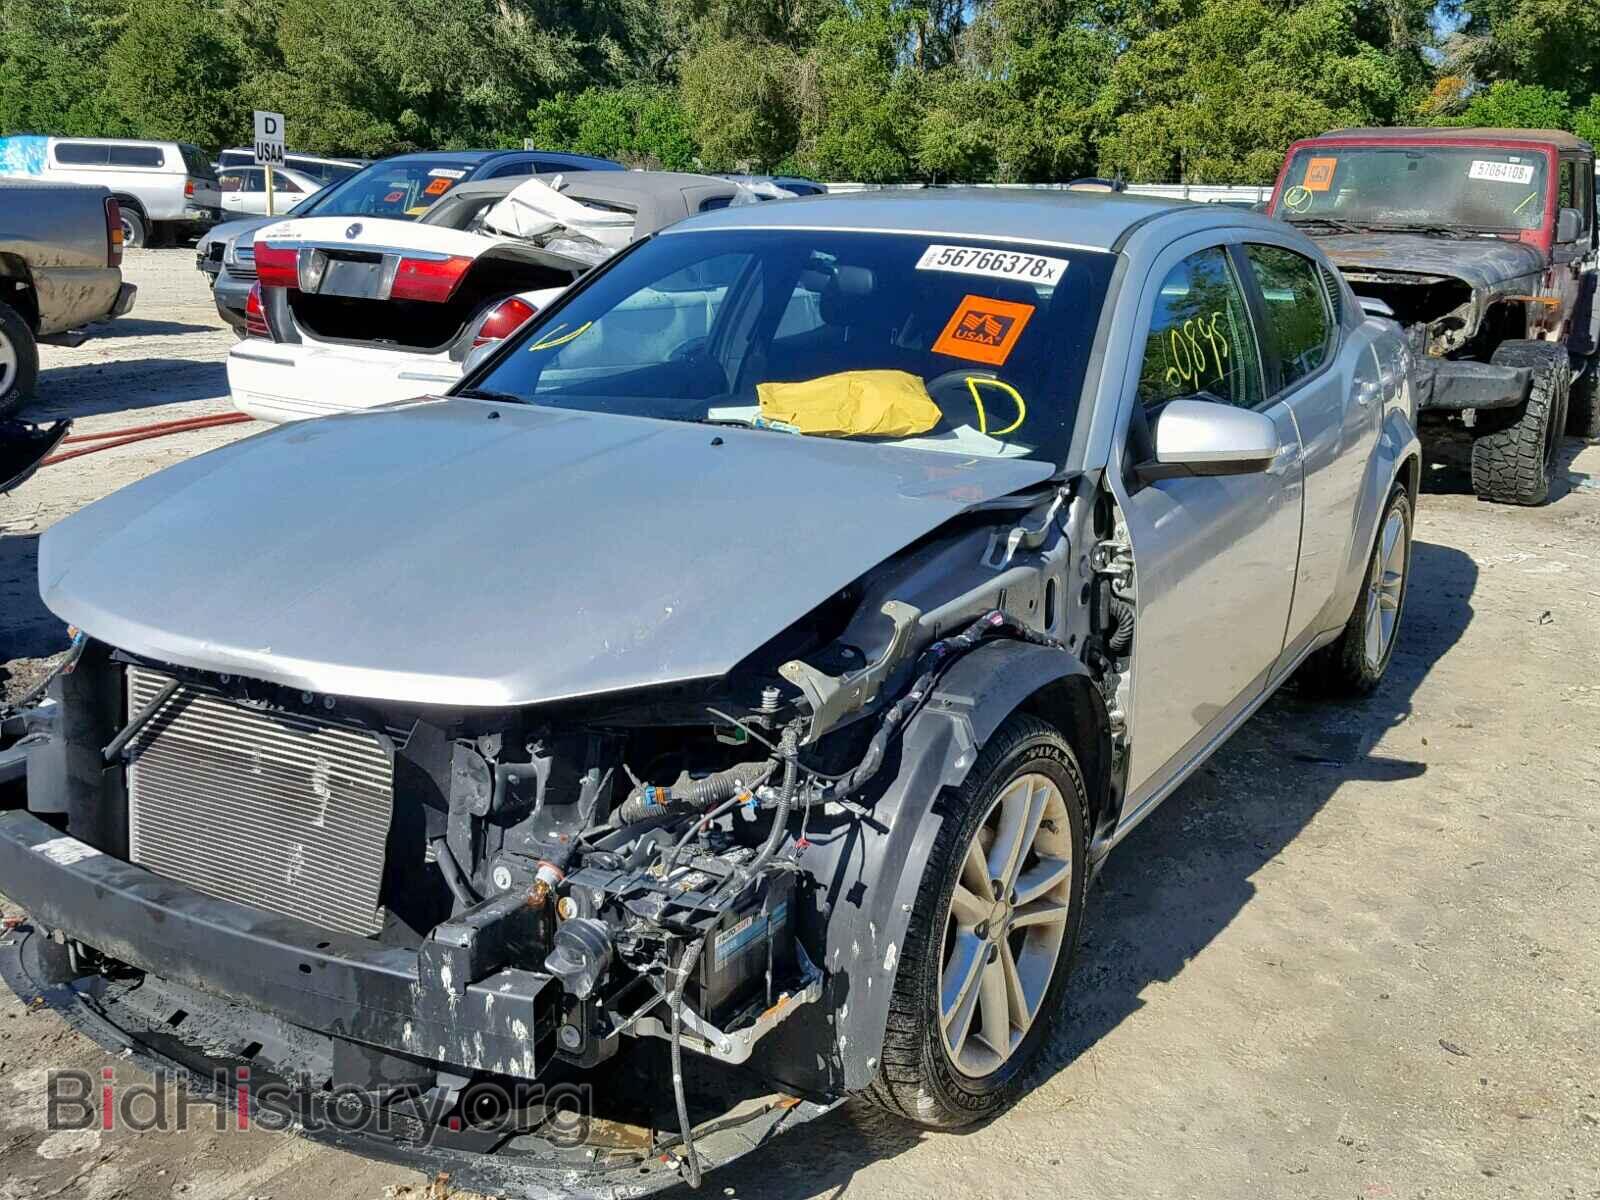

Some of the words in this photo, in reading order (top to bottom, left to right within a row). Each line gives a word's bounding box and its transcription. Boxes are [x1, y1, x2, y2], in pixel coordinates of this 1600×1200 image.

[265, 117, 277, 134] D
[256, 141, 283, 163] USAA
[955, 329, 993, 345] USAA
